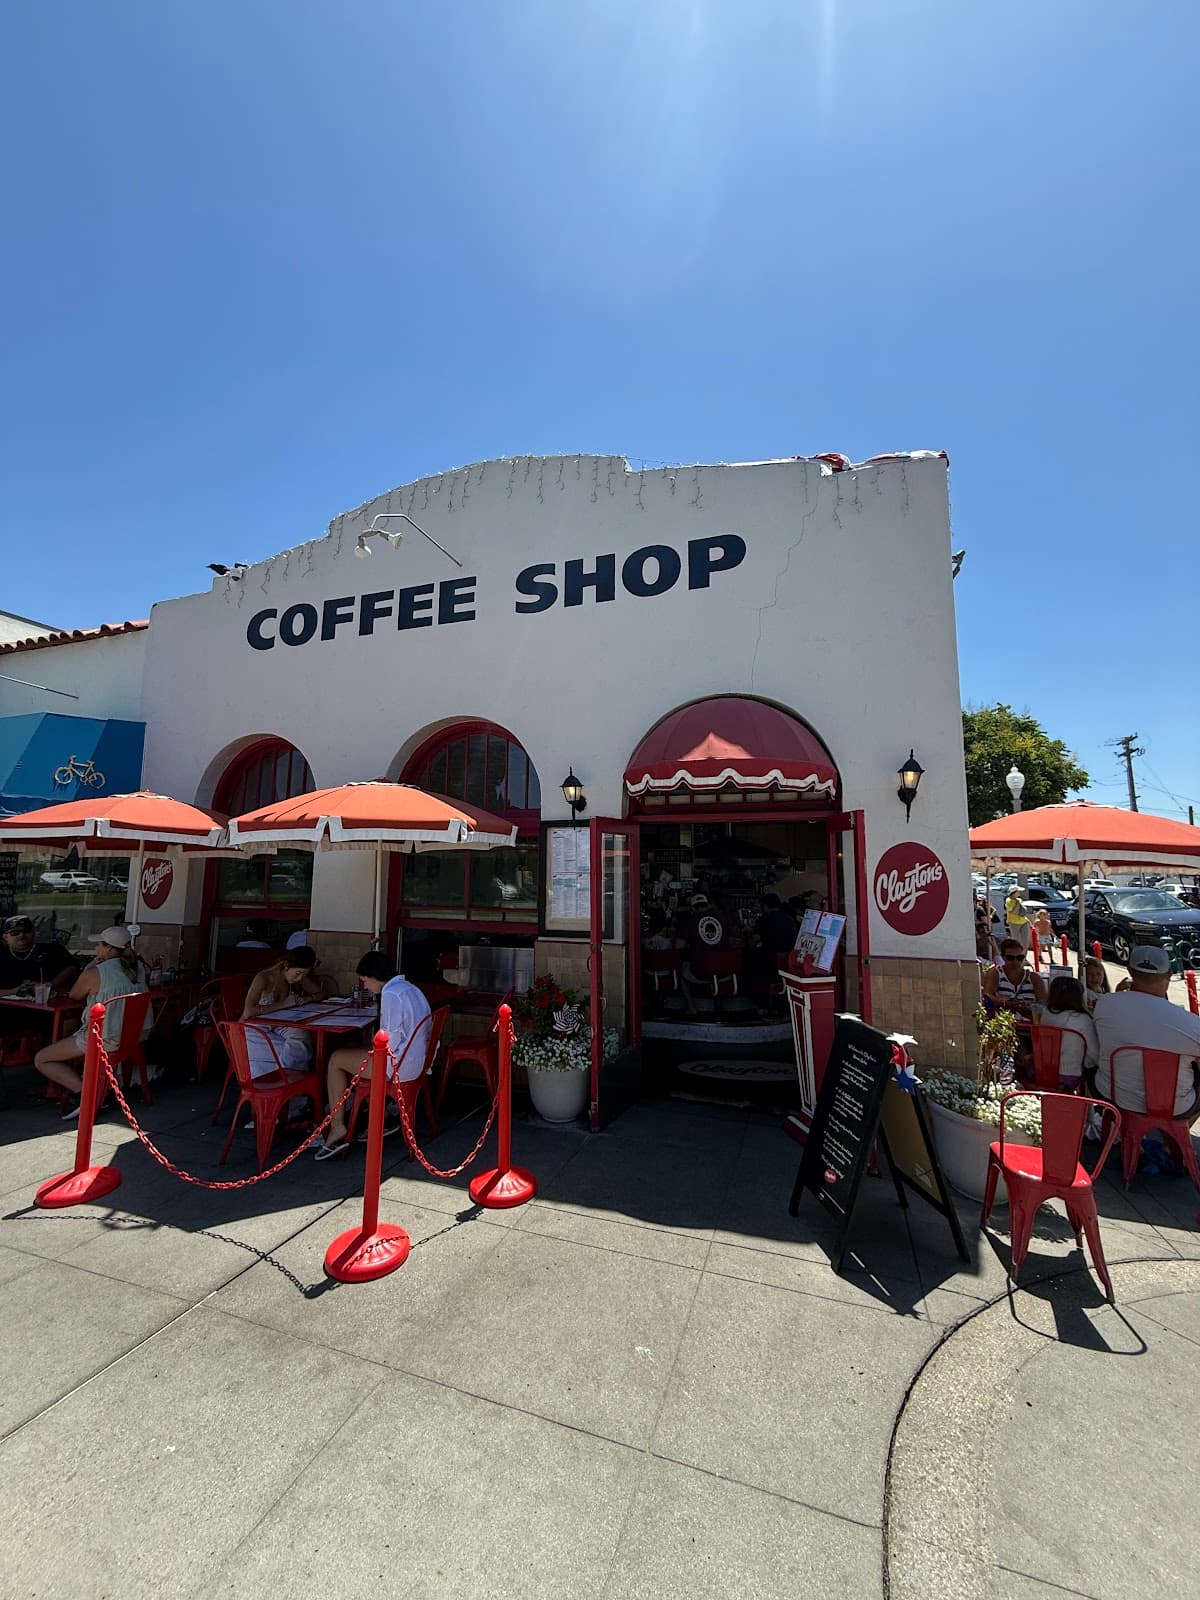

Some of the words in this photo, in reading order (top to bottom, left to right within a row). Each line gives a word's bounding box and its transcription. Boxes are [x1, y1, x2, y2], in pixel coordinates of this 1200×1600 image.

[246, 576, 477, 651] COFFEE
[515, 533, 747, 614] SHOP
[876, 862, 943, 913] Clayton's
